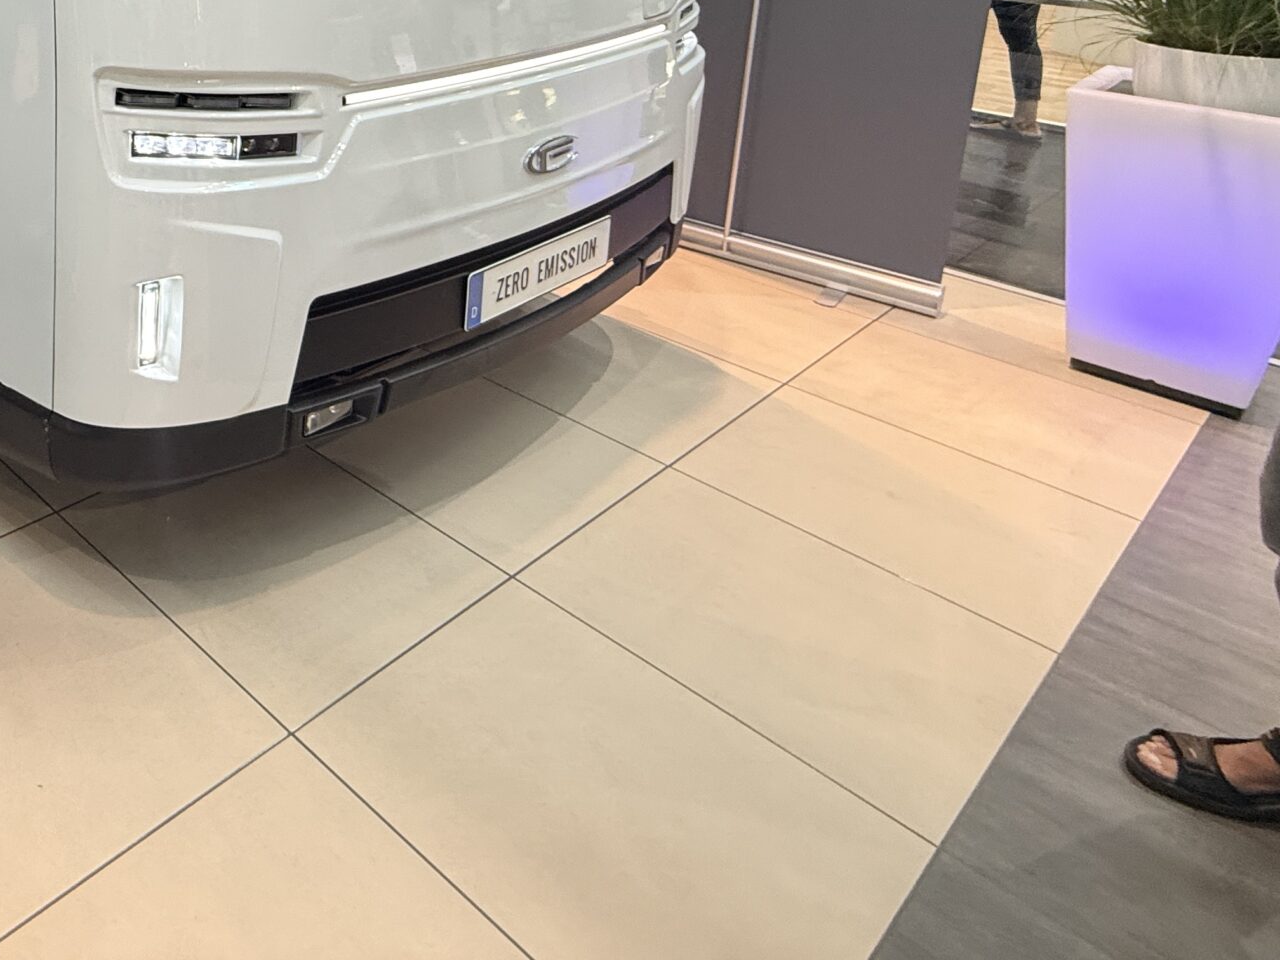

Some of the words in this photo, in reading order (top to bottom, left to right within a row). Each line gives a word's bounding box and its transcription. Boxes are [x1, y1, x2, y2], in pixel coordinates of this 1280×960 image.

[496, 266, 530, 303] ZERO
[537, 237, 597, 284] EMISSION
[471, 306, 478, 319] D
